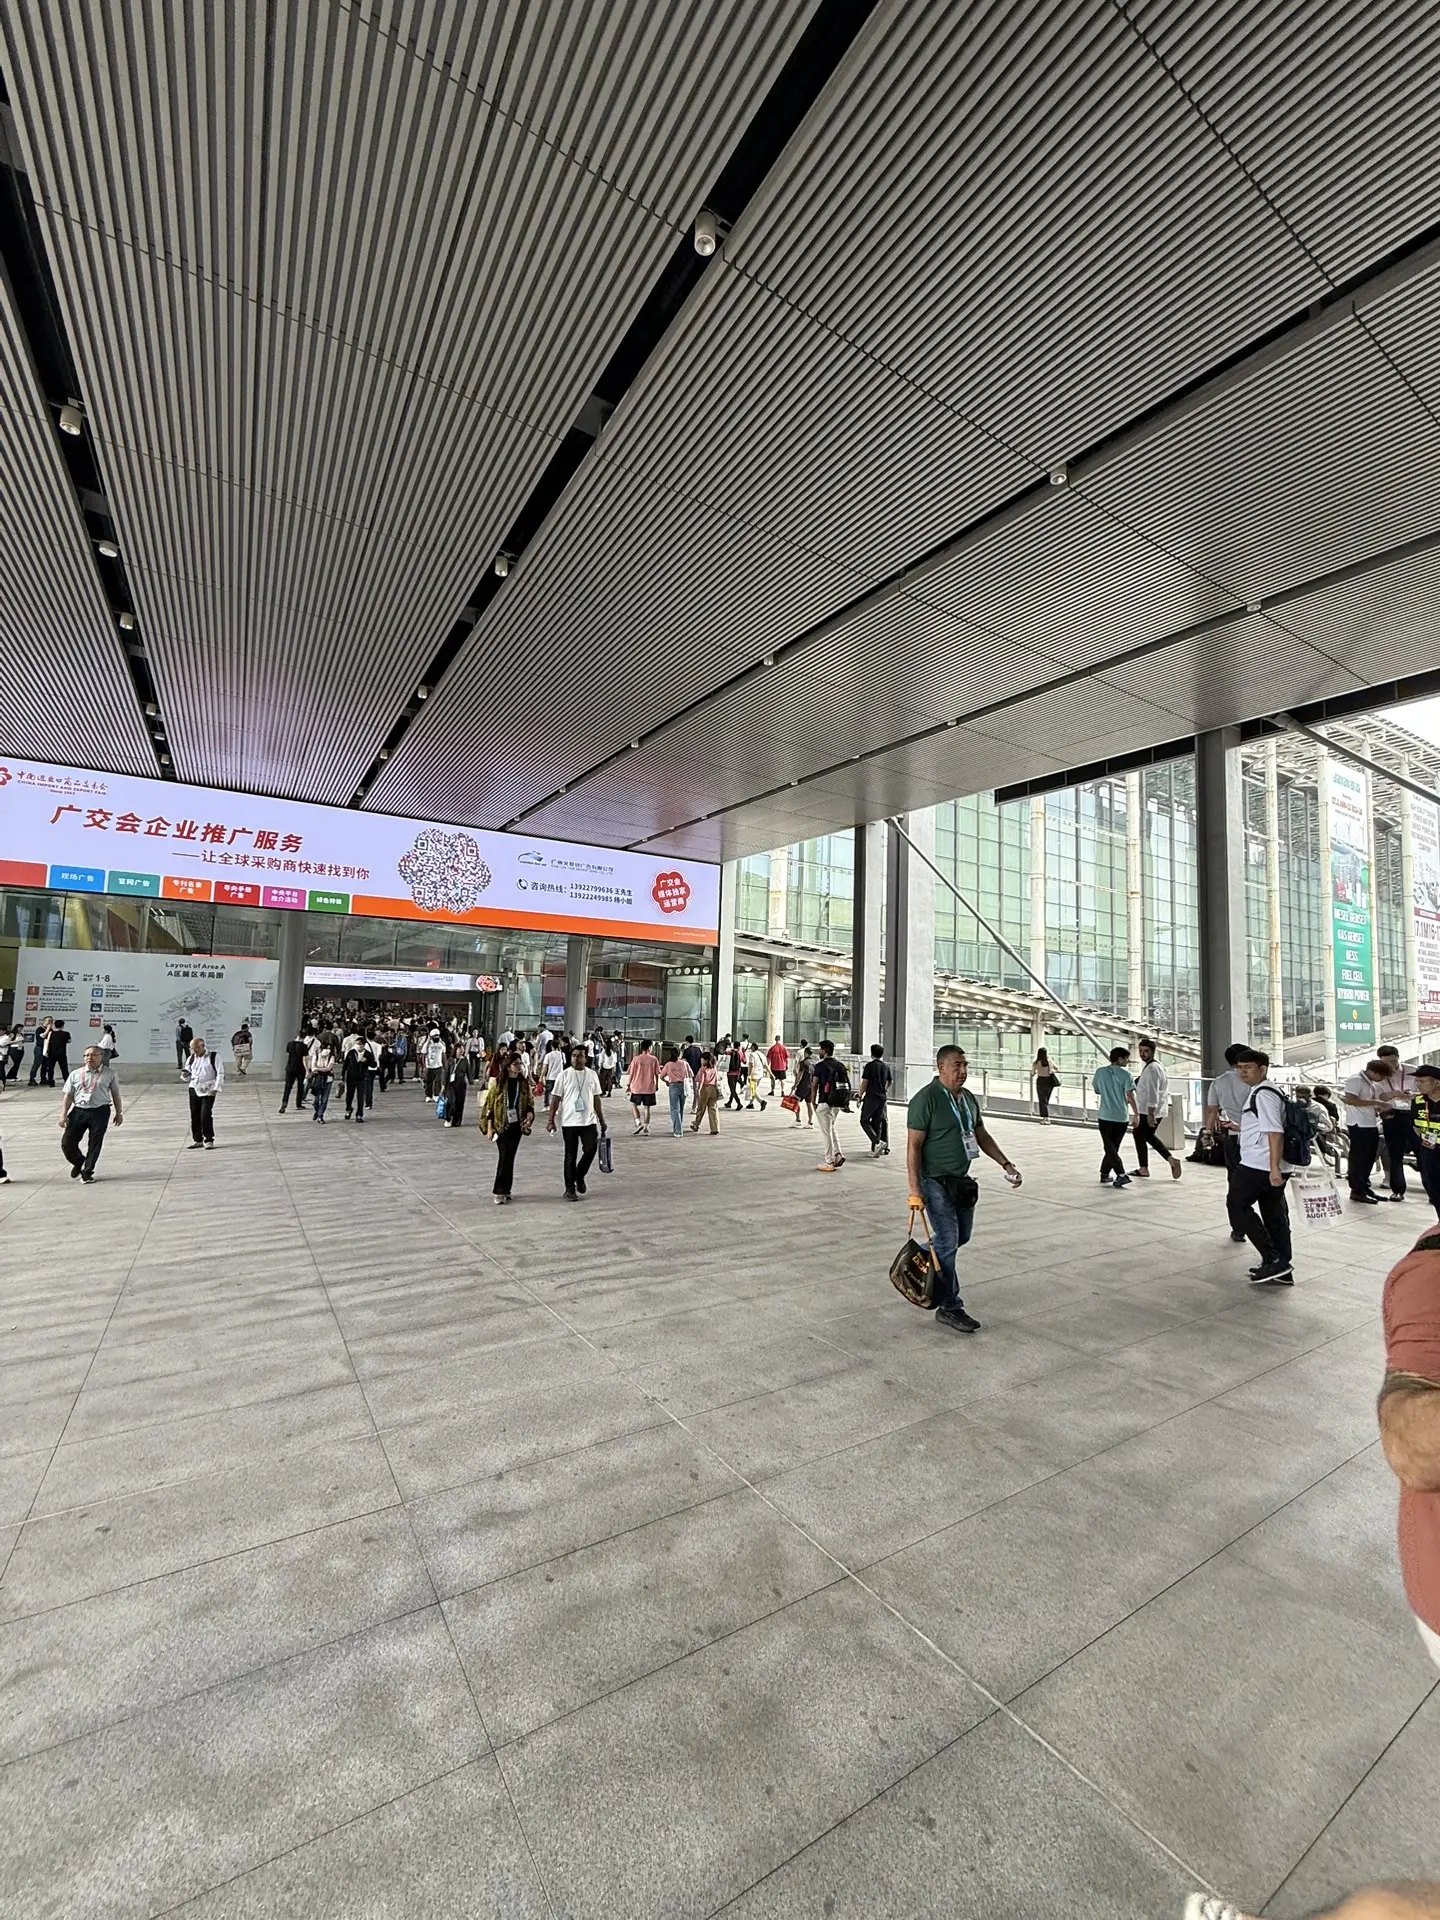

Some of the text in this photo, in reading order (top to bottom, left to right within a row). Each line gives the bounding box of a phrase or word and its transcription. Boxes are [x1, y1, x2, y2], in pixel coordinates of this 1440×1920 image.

[37, 782, 59, 790] IMPORT
[50, 804, 303, 853] 广交会企业推广服务
[60, 872, 95, 882] 现场广告
[118, 877, 150, 888] 官网广告
[660, 878, 681, 888] 广交会
[179, 887, 195, 895] 广告
[230, 891, 244, 899] 广告
[614, 888, 633, 897] 王先生
[165, 962, 192, 970] Layout
[52, 971, 64, 981] A
[95, 974, 111, 982] 1-8
[167, 969, 224, 979] A区展区布局图
